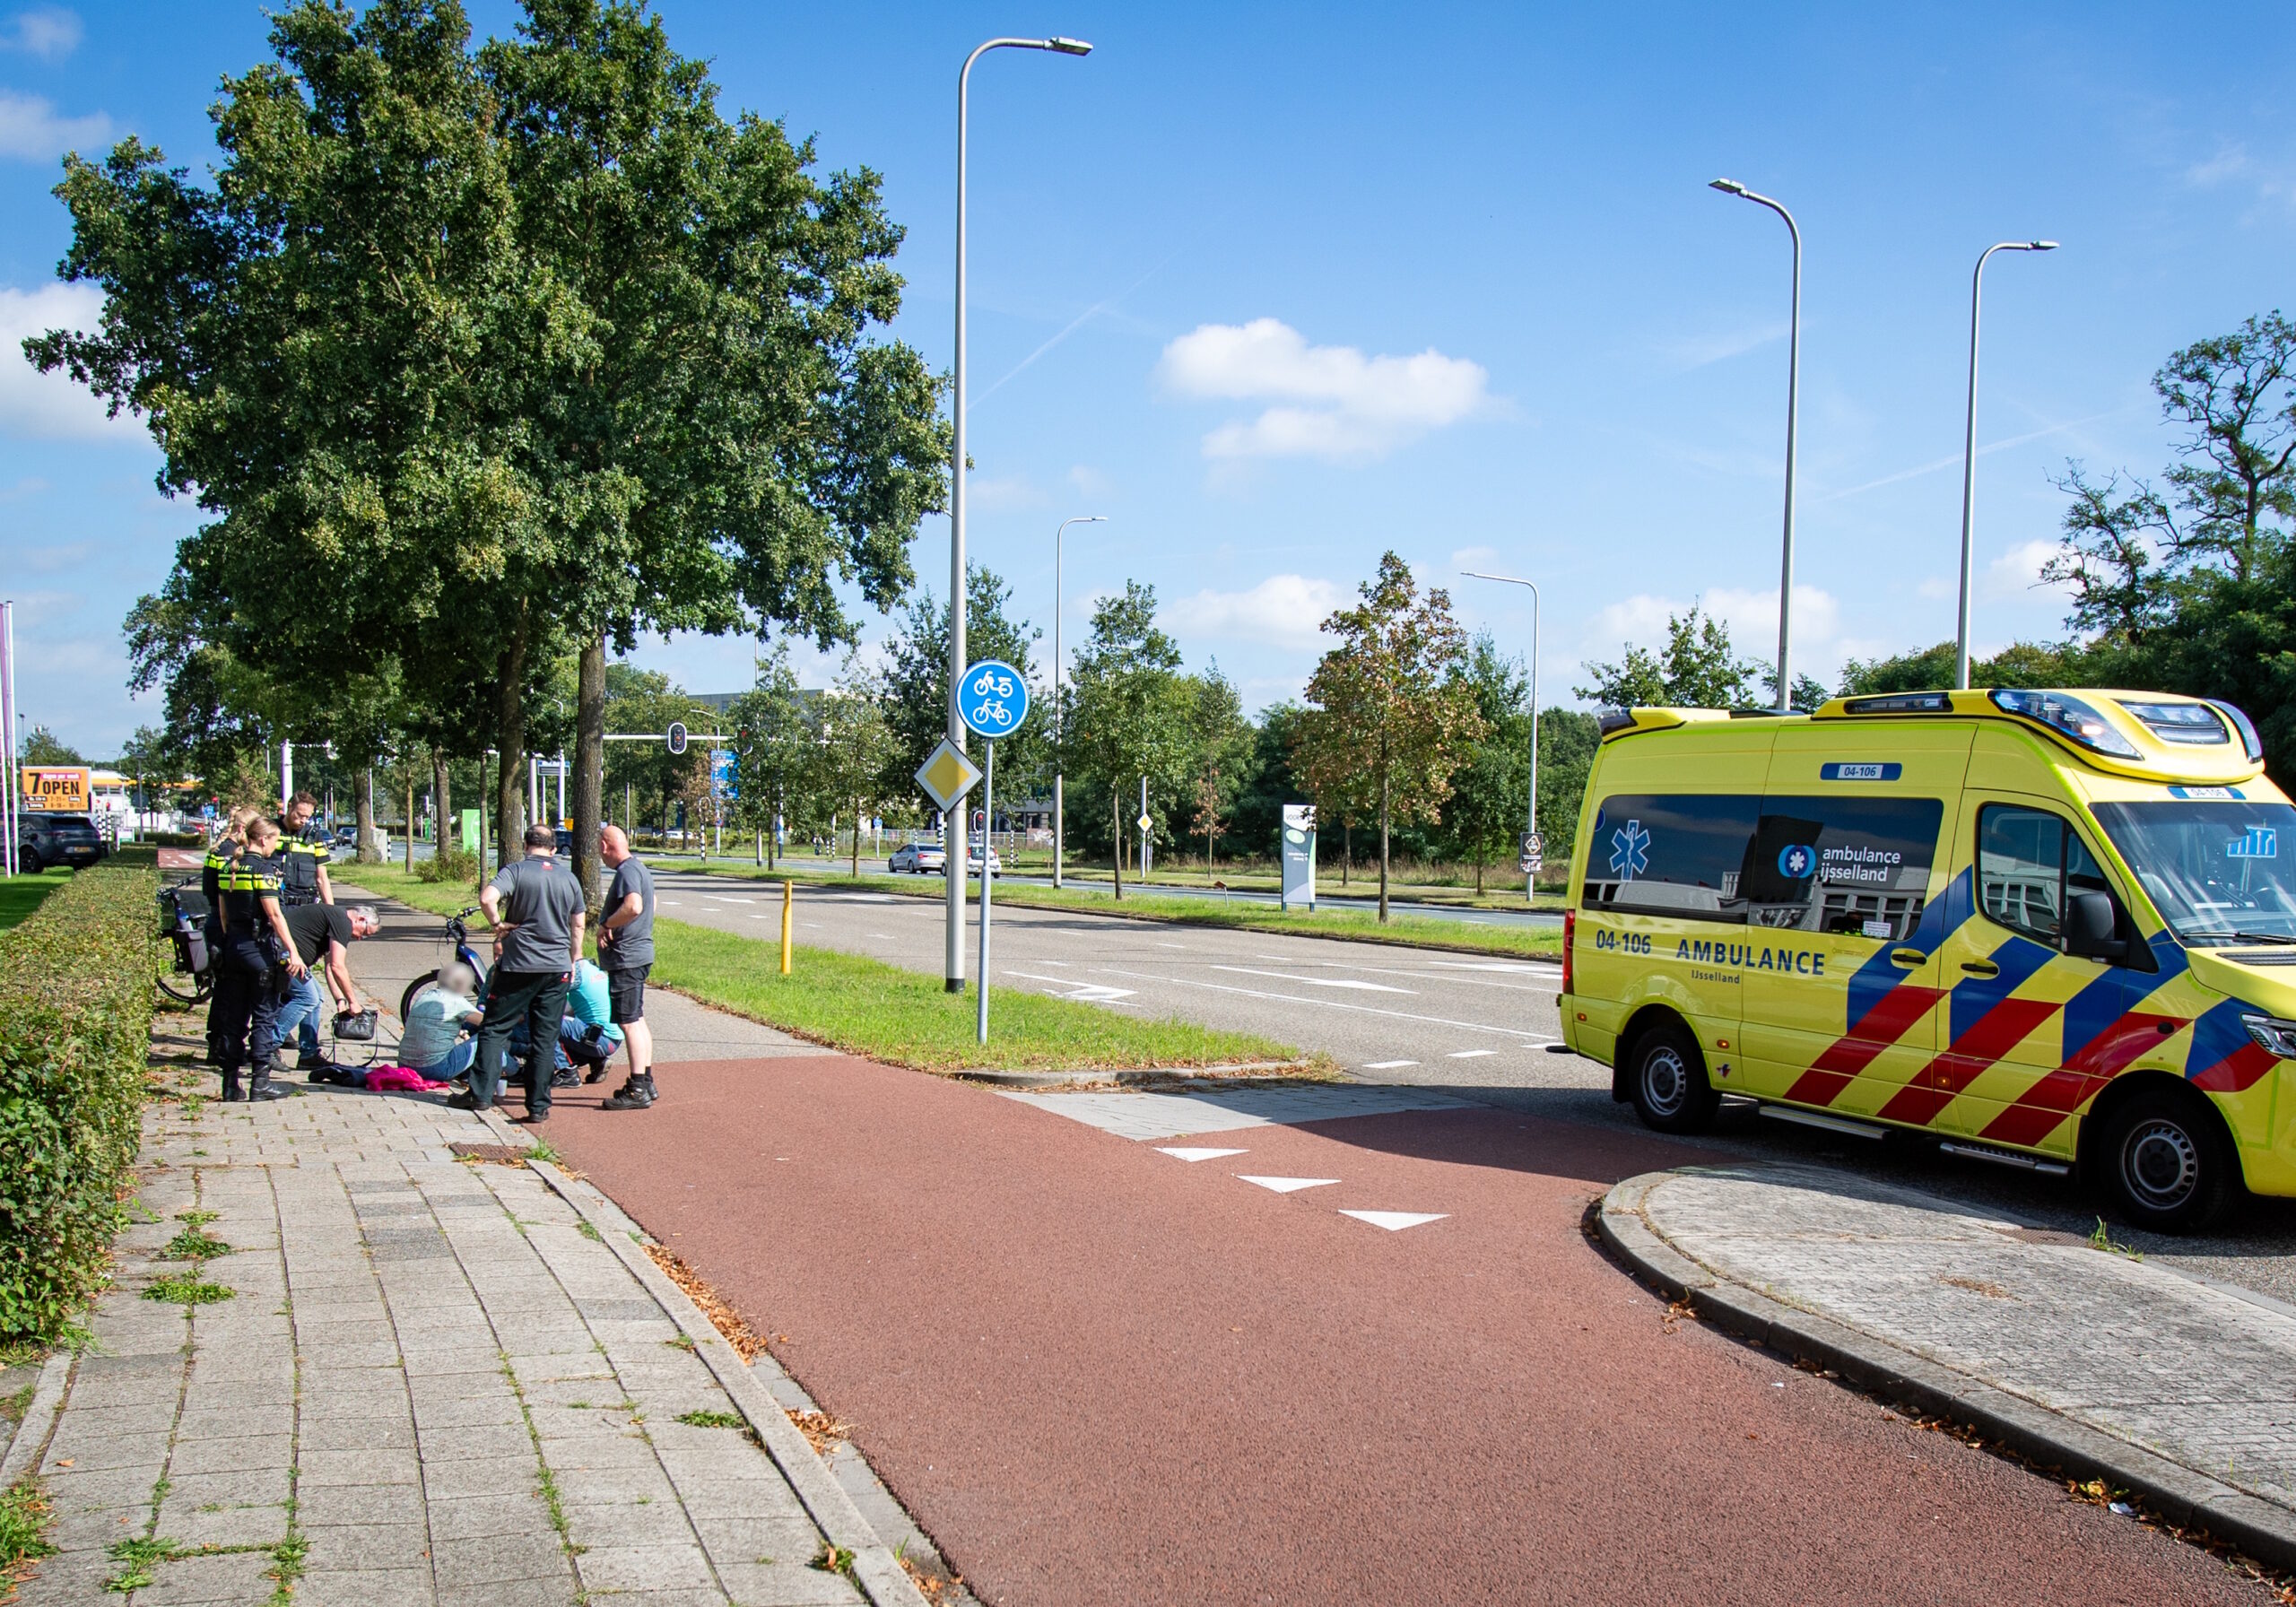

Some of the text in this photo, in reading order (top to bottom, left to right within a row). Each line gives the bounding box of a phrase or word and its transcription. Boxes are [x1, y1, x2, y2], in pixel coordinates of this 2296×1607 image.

[1844, 767, 1876, 777] 04-106
[29, 772, 40, 795] 7
[42, 781, 80, 795] OPEN
[1822, 846, 1900, 864] ambulance
[1821, 863, 1889, 882] ijsselland
[1596, 929, 1825, 976] 04-106 AMBULANCE
[1691, 969, 1740, 985] IJsselland
